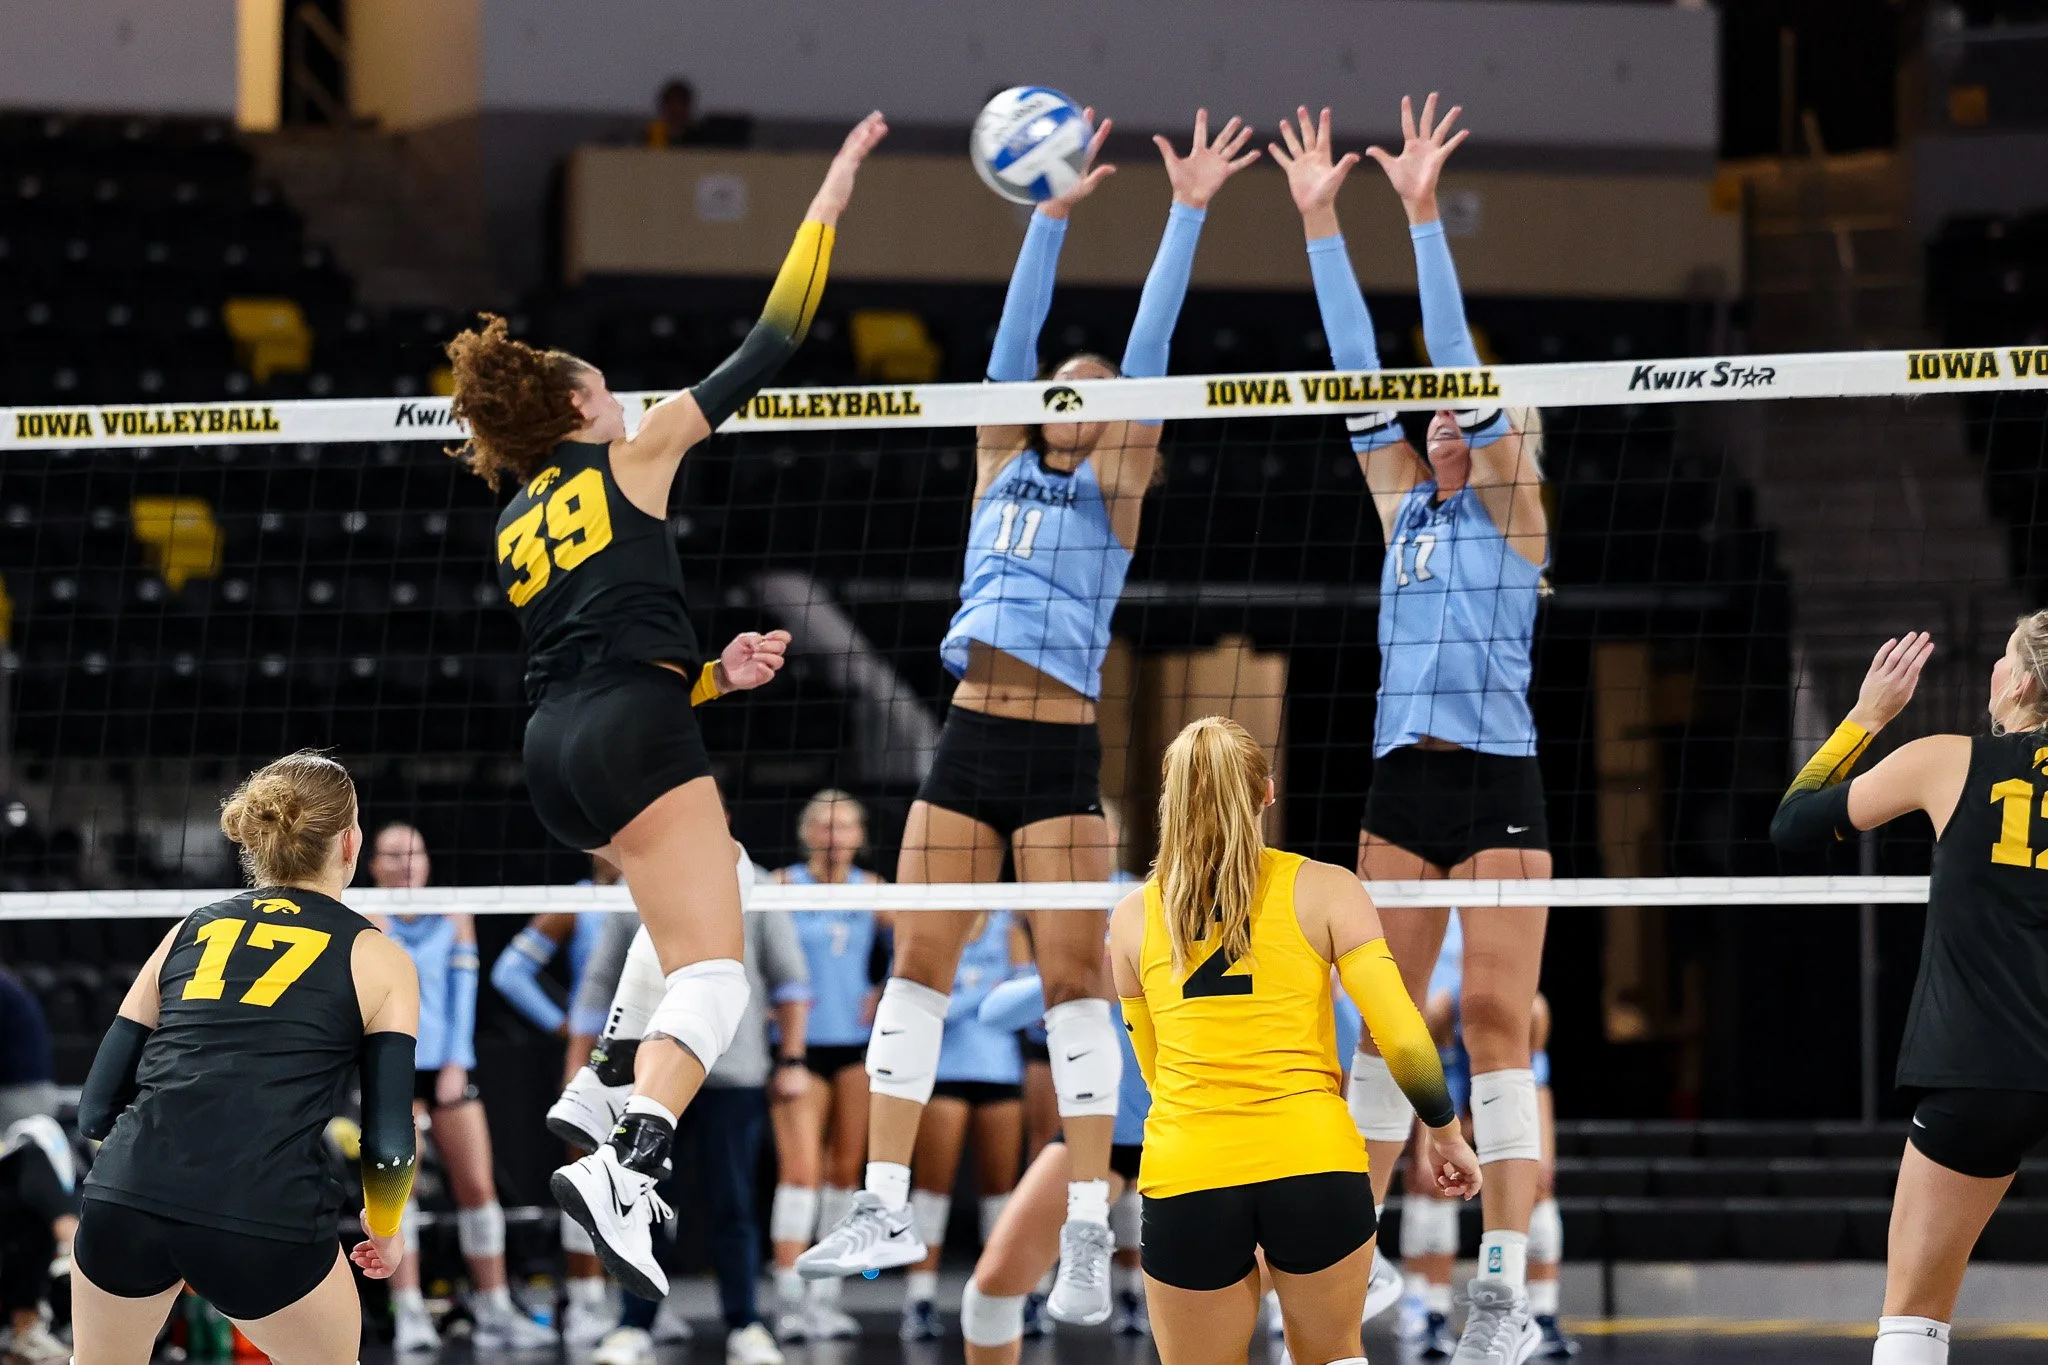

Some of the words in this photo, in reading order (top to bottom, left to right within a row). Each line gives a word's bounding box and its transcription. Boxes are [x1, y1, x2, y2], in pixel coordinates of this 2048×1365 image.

[1206, 379, 1291, 406] IOWA
[1301, 371, 1500, 403] VOLLEYBALL
[1628, 365, 1707, 391] KWIK
[1907, 352, 1999, 380] IOWA
[16, 412, 93, 438] IOWA
[103, 407, 280, 436] VOLLEYBALL
[498, 467, 613, 608] 39
[992, 502, 1043, 560] 11
[181, 917, 332, 1008] 17
[1182, 900, 1254, 999] 2
